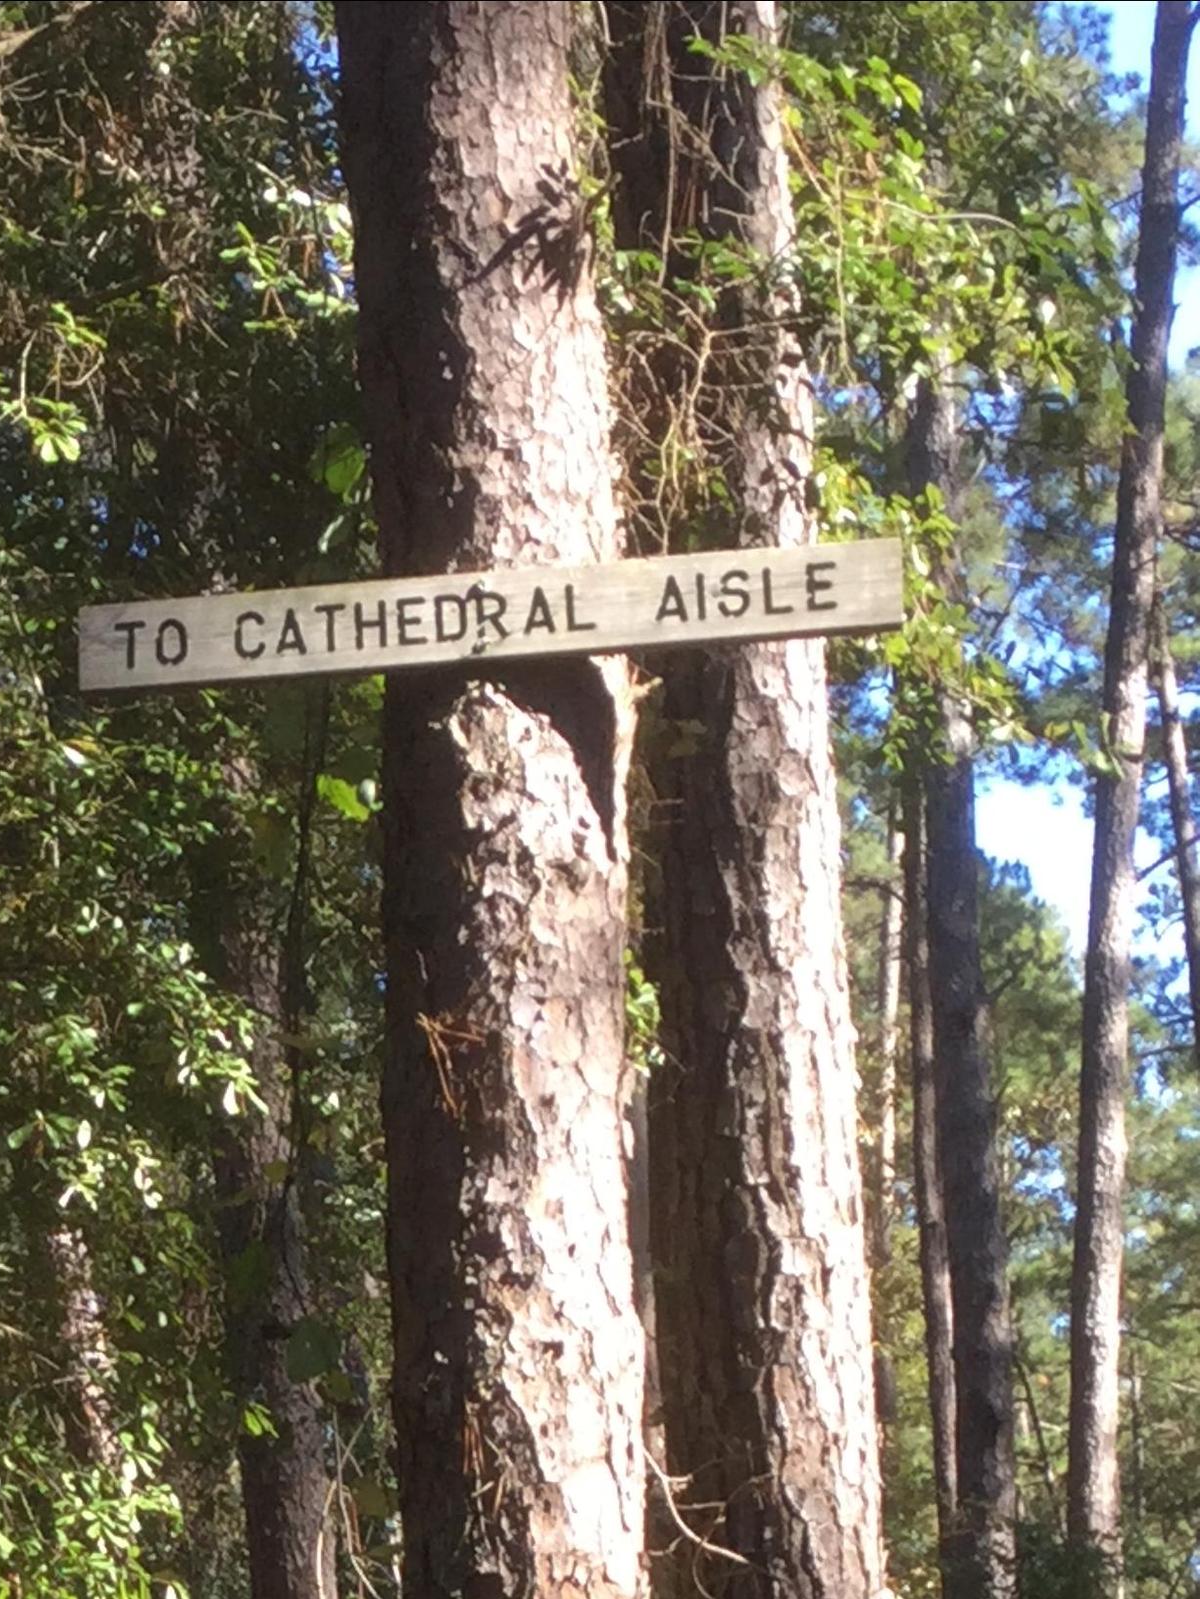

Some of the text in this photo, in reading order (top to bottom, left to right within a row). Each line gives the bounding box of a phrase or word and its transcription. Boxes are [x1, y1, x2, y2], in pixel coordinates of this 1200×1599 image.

[114, 561, 838, 670] TO CATHEDRAL AISLE
